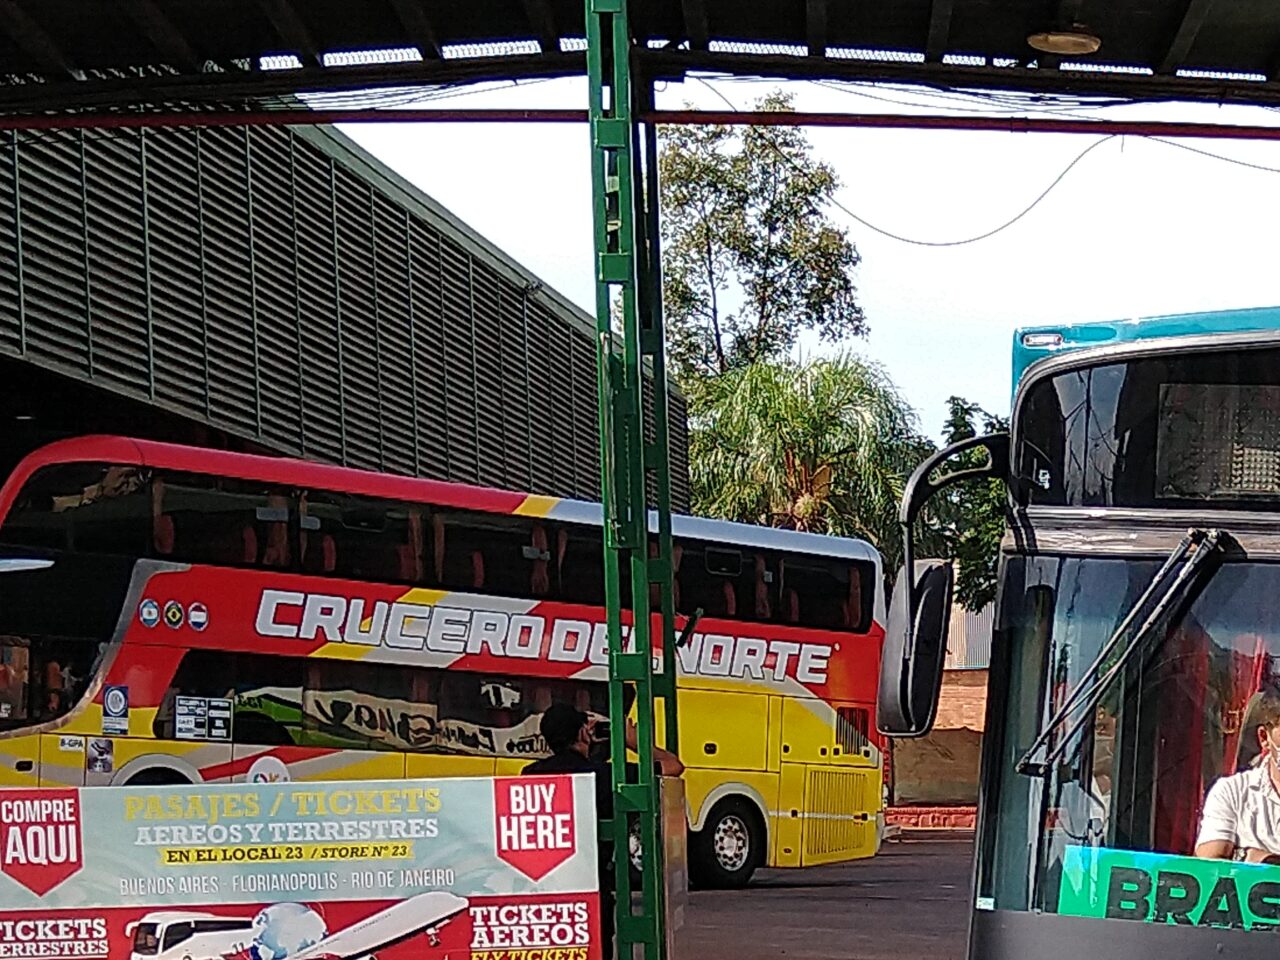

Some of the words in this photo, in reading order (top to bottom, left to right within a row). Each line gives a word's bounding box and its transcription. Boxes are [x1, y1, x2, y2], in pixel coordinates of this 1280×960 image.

[255, 588, 546, 660] CRUCERO
[675, 632, 831, 684] NORTE
[1, 799, 76, 823] COMPRE
[123, 792, 260, 824] PASAJES
[269, 792, 285, 817] /
[292, 788, 442, 816] TICKETS
[510, 784, 555, 814] BUY
[5, 825, 78, 866] AQUI
[134, 824, 243, 846] AEREOS
[245, 823, 263, 843] Y
[268, 818, 439, 843] TERRESTRES
[500, 814, 572, 850] HERE
[166, 850, 190, 862] EN
[196, 848, 218, 861] EL
[222, 847, 282, 862] LOCAL
[285, 847, 303, 859] 23
[321, 846, 369, 858] STORE
[392, 845, 407, 857] 23
[120, 877, 175, 896] BUENOS
[179, 875, 219, 894] AIRES
[233, 872, 338, 893] FLORIANOPOLIS
[352, 871, 374, 889] RIO
[378, 870, 394, 887] DE
[400, 868, 455, 887] JANEIRO
[469, 902, 588, 926] TICKETS
[0, 940, 109, 957] ERRESTRES
[470, 923, 590, 948] AEREOS
